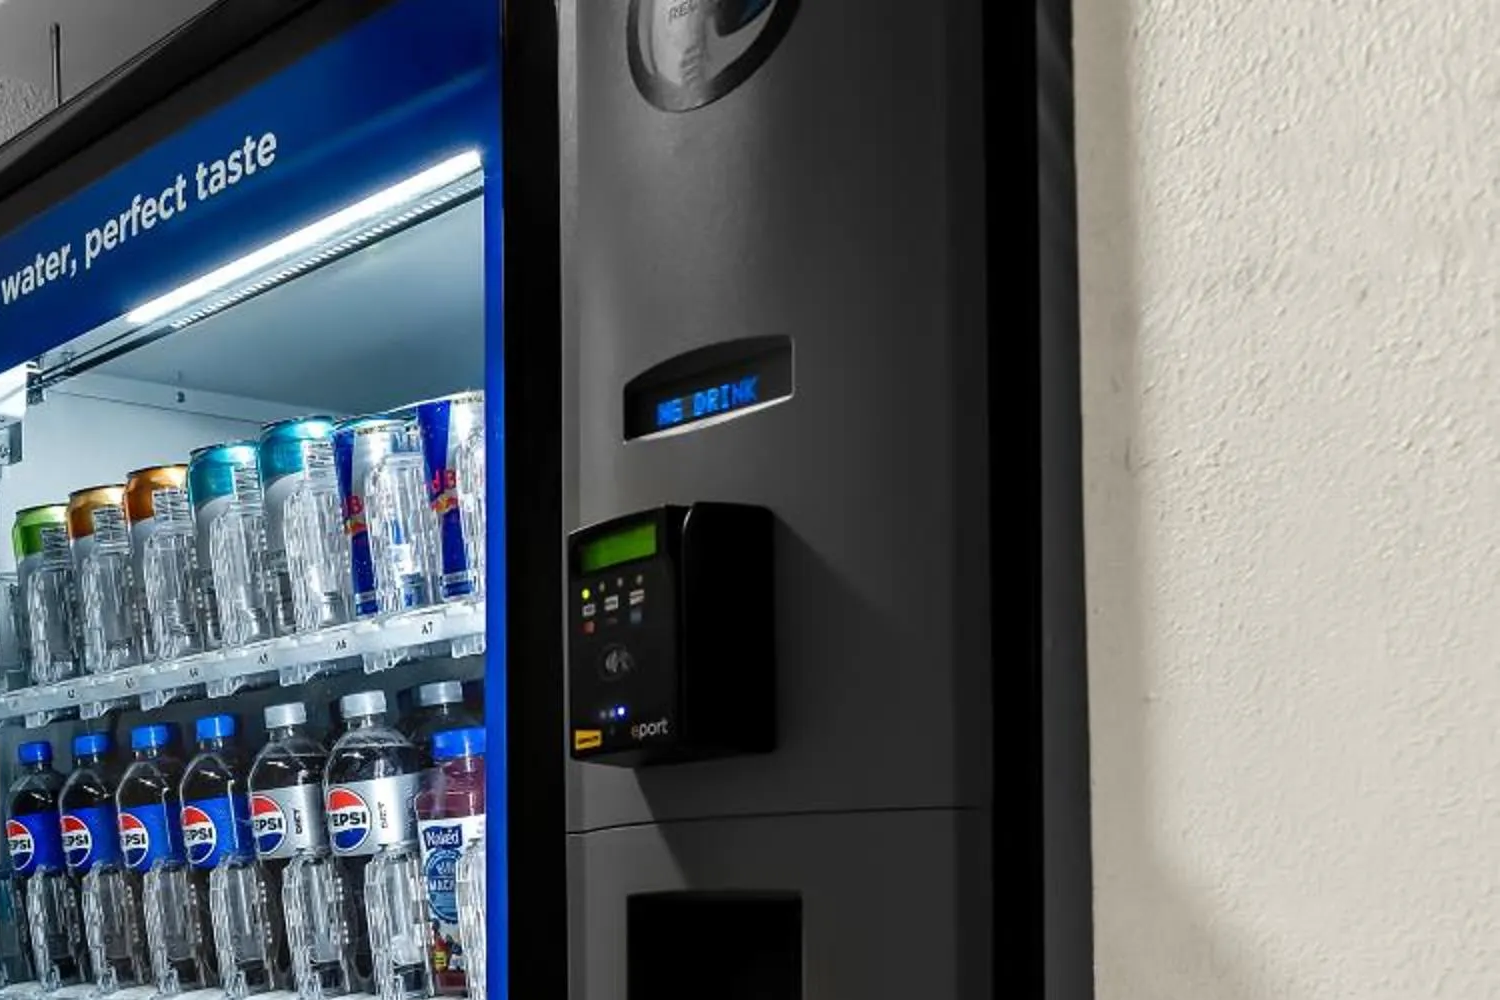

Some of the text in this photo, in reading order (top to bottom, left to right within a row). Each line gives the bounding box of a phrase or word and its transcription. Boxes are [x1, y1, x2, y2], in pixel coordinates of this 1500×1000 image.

[1, 242, 77, 306] water,
[85, 173, 188, 269] perfect
[195, 131, 277, 201] taste
[692, 376, 759, 416] DRINK
[253, 817, 283, 831] EPSI
[332, 811, 367, 827] EPSI
[63, 833, 89, 847] EPSI
[186, 828, 213, 842] EPSI
